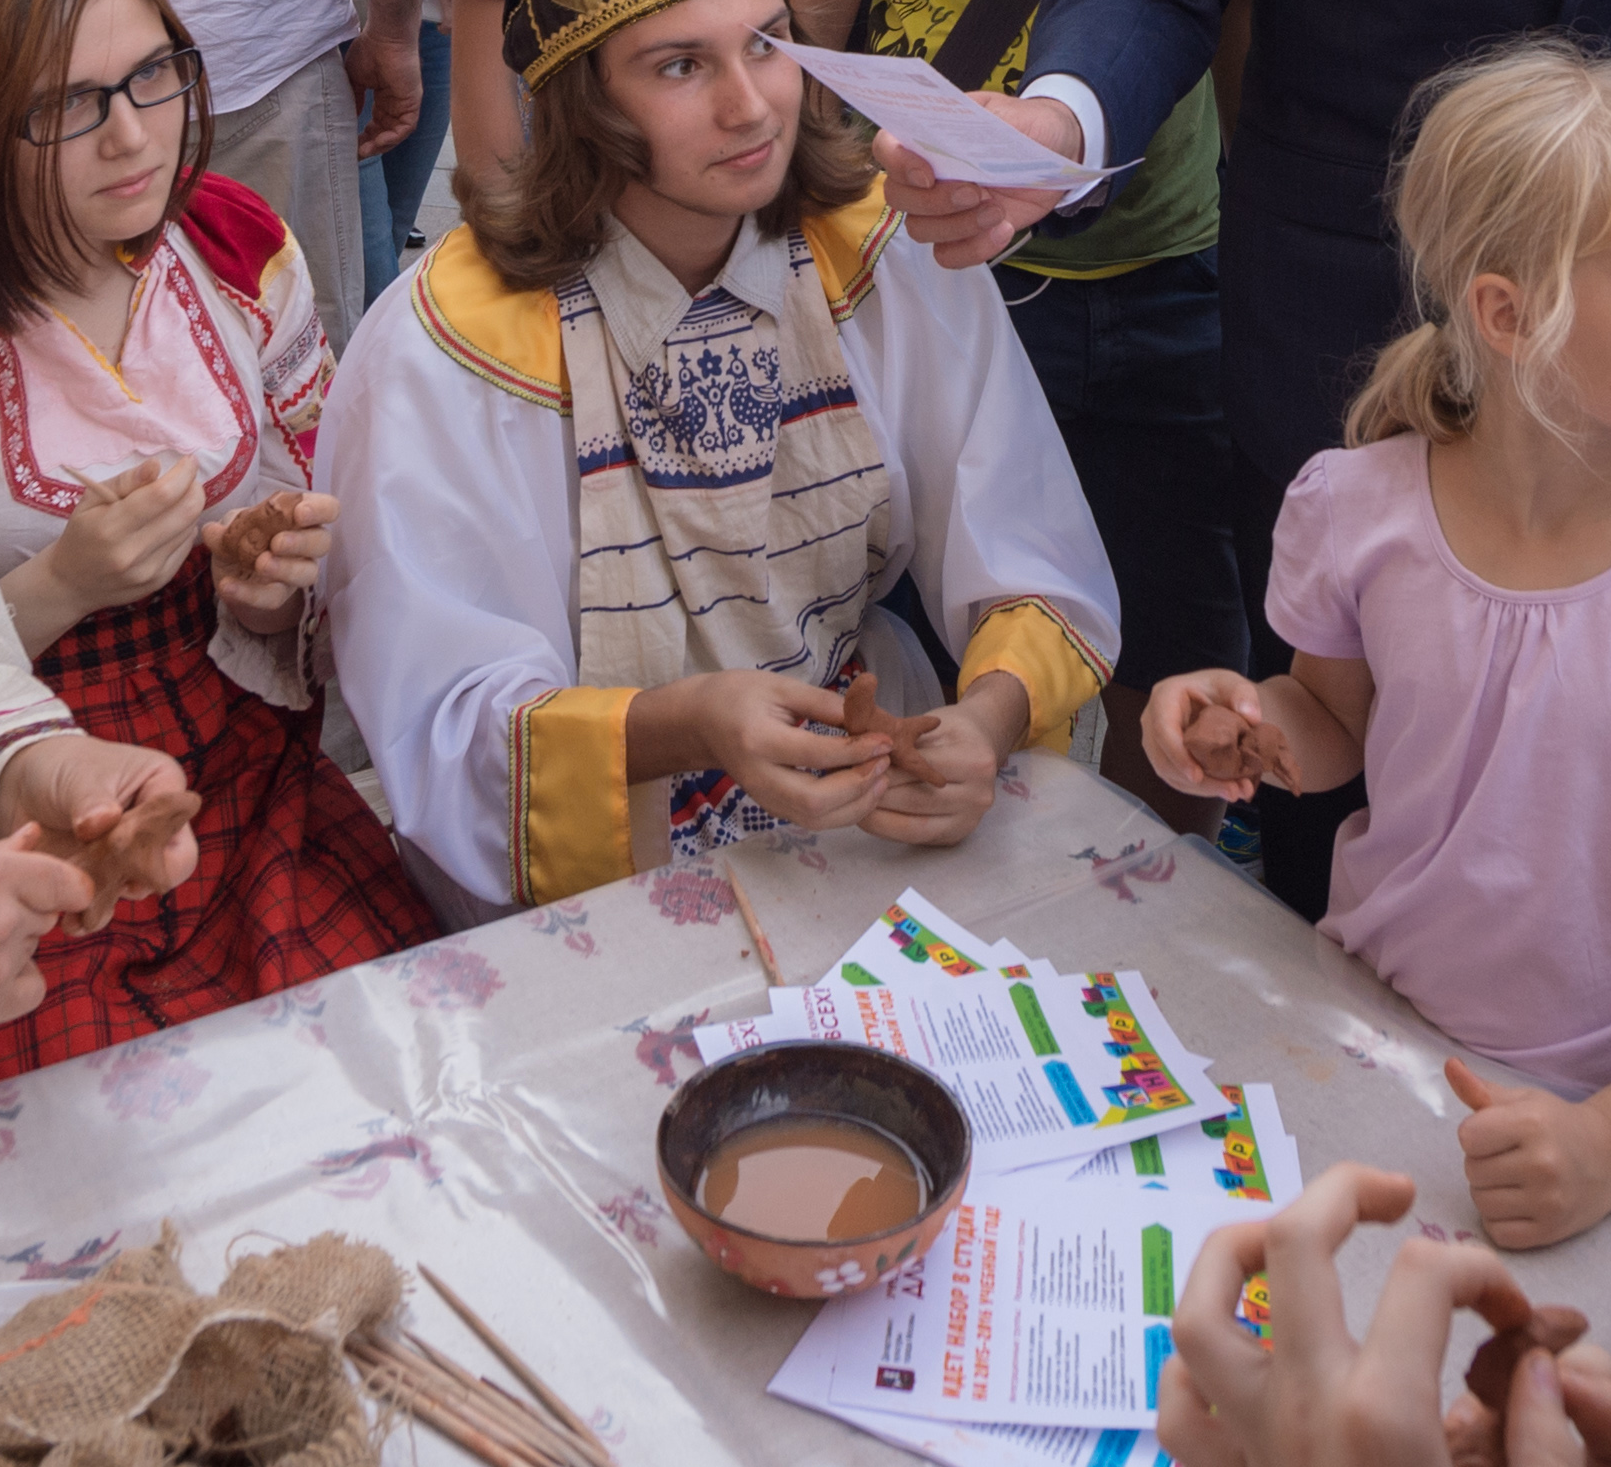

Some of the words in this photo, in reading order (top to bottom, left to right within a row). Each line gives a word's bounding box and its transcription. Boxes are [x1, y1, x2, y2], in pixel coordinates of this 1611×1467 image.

[737, 1019, 762, 1049] ЕХ!
[813, 987, 842, 1040] ВСЕХ!
[953, 1203, 976, 1269] СТУДИИ
[951, 1273, 971, 1284] В
[977, 1239, 997, 1304] УЧЕБНЫЙ
[946, 1287, 969, 1347] НАБОР
[942, 1351, 965, 1399] ИДЕТ
[972, 1383, 988, 1401] НА
